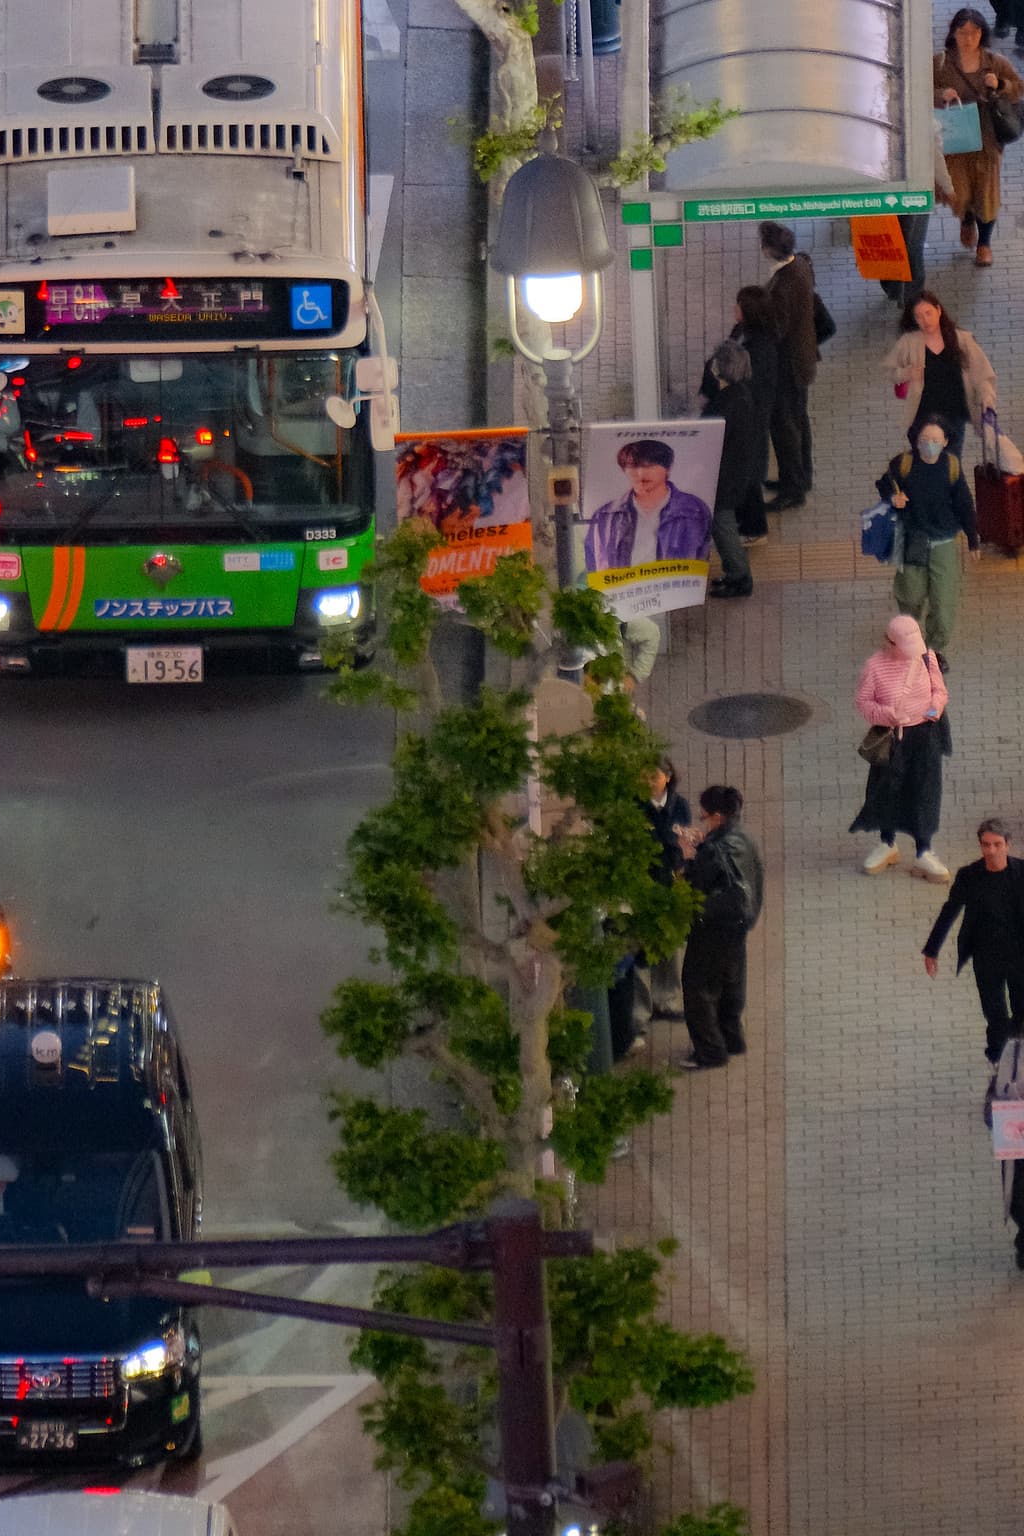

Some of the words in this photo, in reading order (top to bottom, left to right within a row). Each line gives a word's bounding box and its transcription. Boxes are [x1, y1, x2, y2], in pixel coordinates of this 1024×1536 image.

[759, 203, 788, 213] Shibuya
[148, 313, 192, 322] WASEDA
[198, 311, 234, 321] UNIV.
[305, 528, 337, 541] D333
[639, 563, 690, 577] Inomata
[96, 601, 233, 617] ノンステップバス
[143, 659, 200, 681] 19-56
[29, 1432, 75, 1449] 27-36
